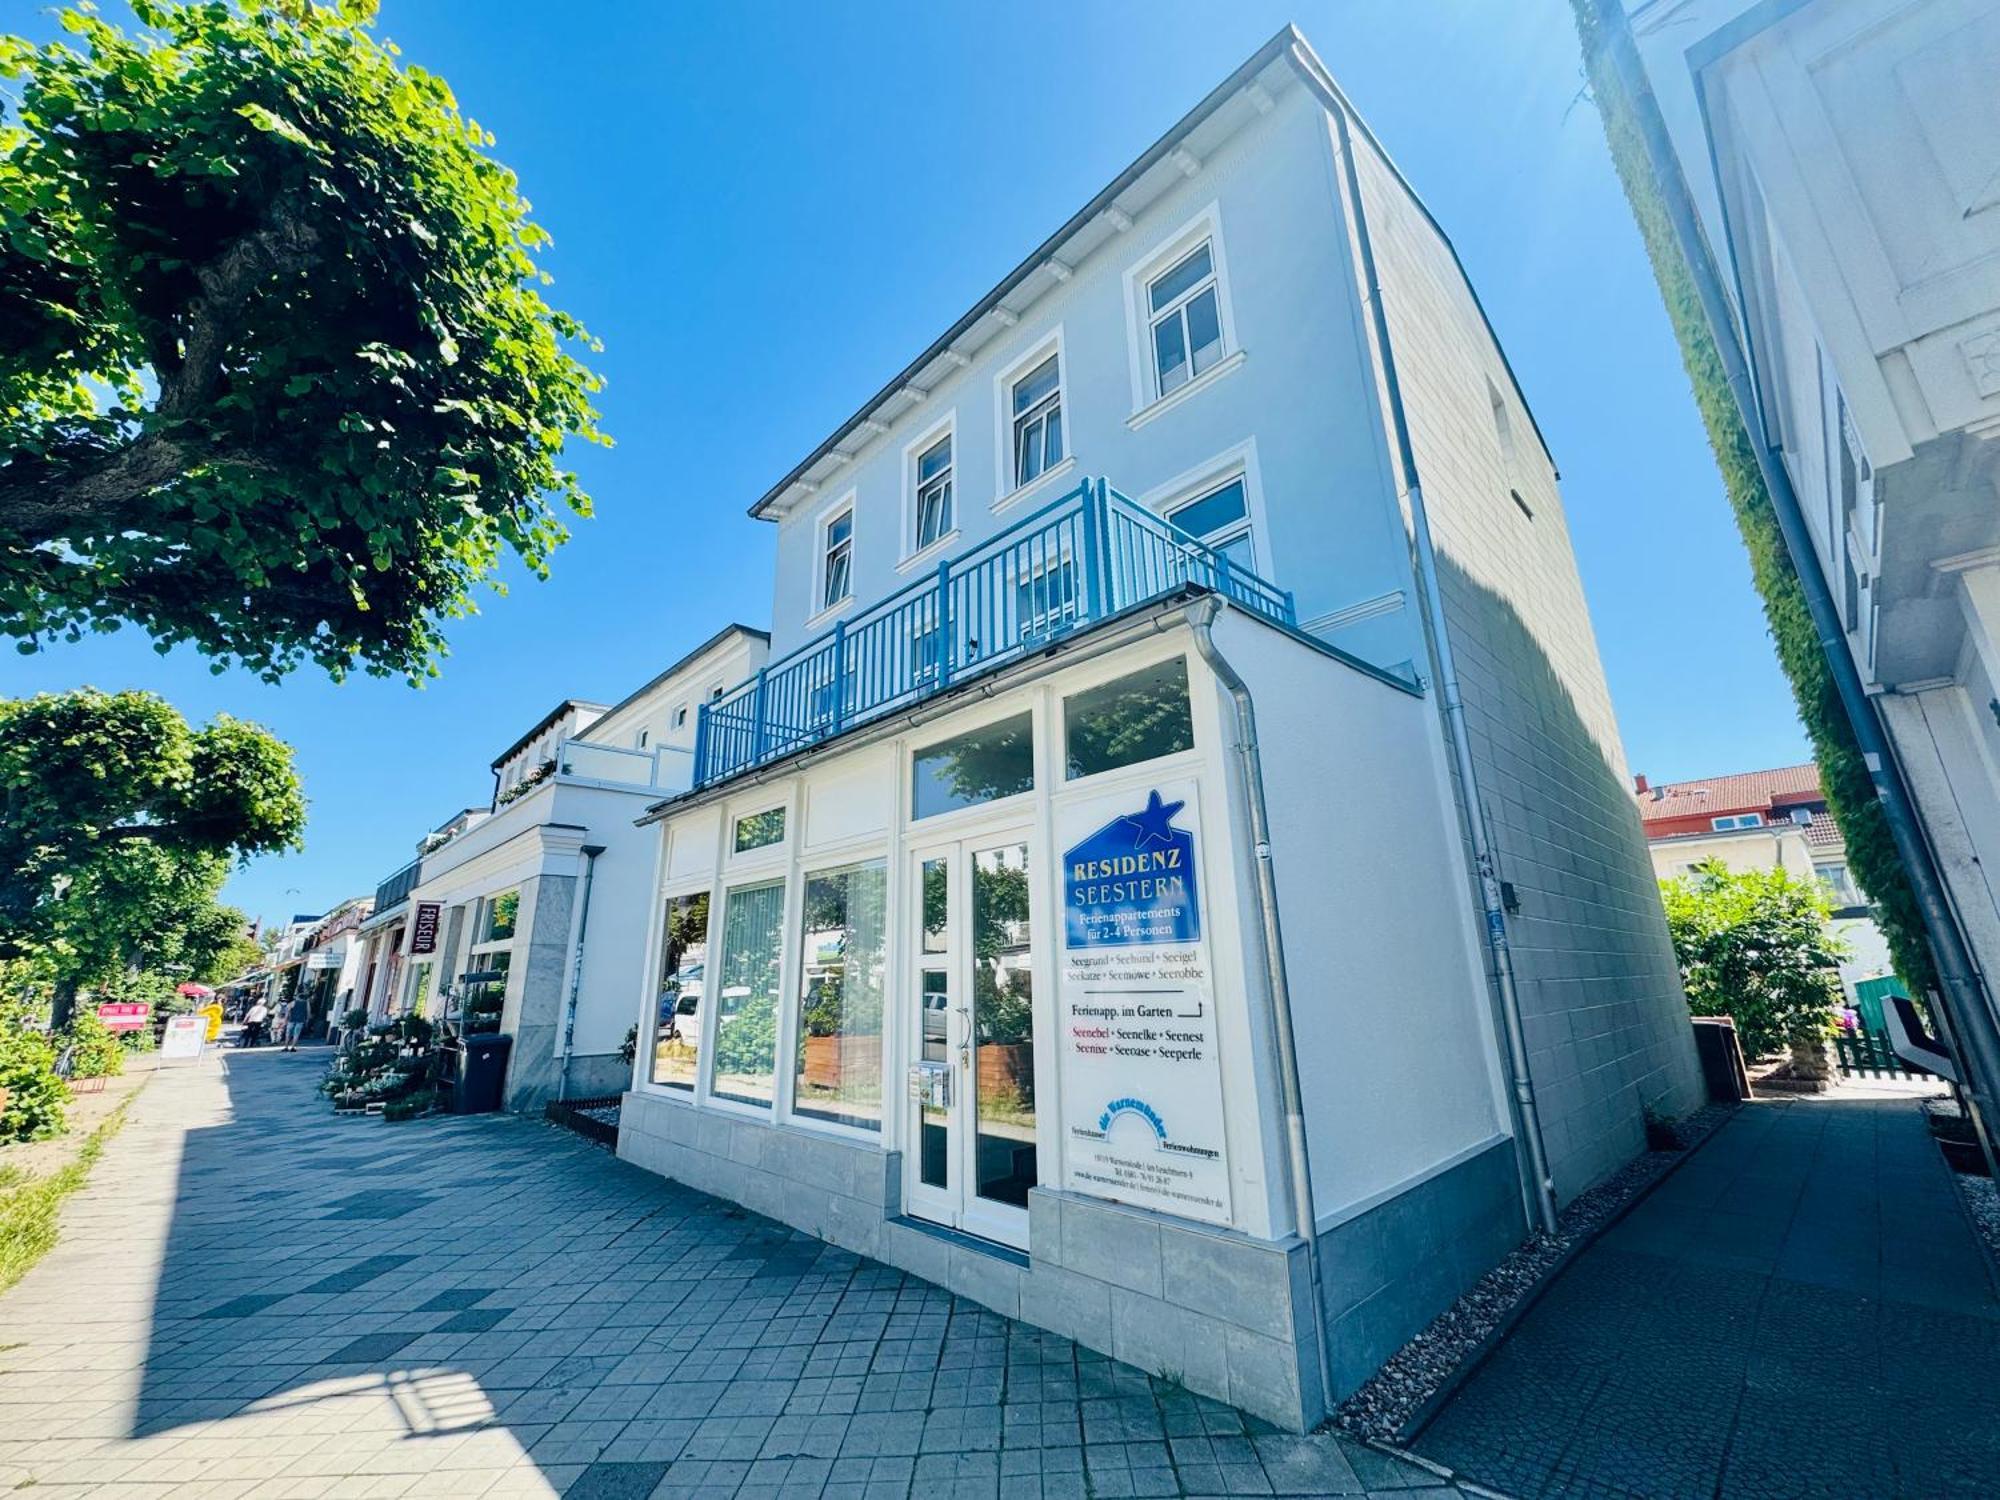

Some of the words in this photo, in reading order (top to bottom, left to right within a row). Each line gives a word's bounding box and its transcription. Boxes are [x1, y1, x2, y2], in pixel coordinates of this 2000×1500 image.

[1074, 848, 1182, 881] RESIDENZ
[1075, 875, 1183, 906] SEESTERN
[1079, 906, 1181, 926] Ferienappartements
[415, 908, 437, 950] FRISEUR
[1087, 928, 1101, 940] für
[1103, 927, 1121, 938] 2-4
[1123, 925, 1172, 937] Personen
[1115, 953, 1154, 965] Seehund
[1162, 950, 1197, 965] Seeigel
[1158, 967, 1203, 979] Seerobbe
[1122, 1005, 1135, 1017] im
[1137, 1004, 1173, 1017] Garten
[1116, 1028, 1157, 1040] Seenelke
[1165, 1029, 1204, 1042] Seenest
[1158, 1046, 1202, 1062] Seeperle
